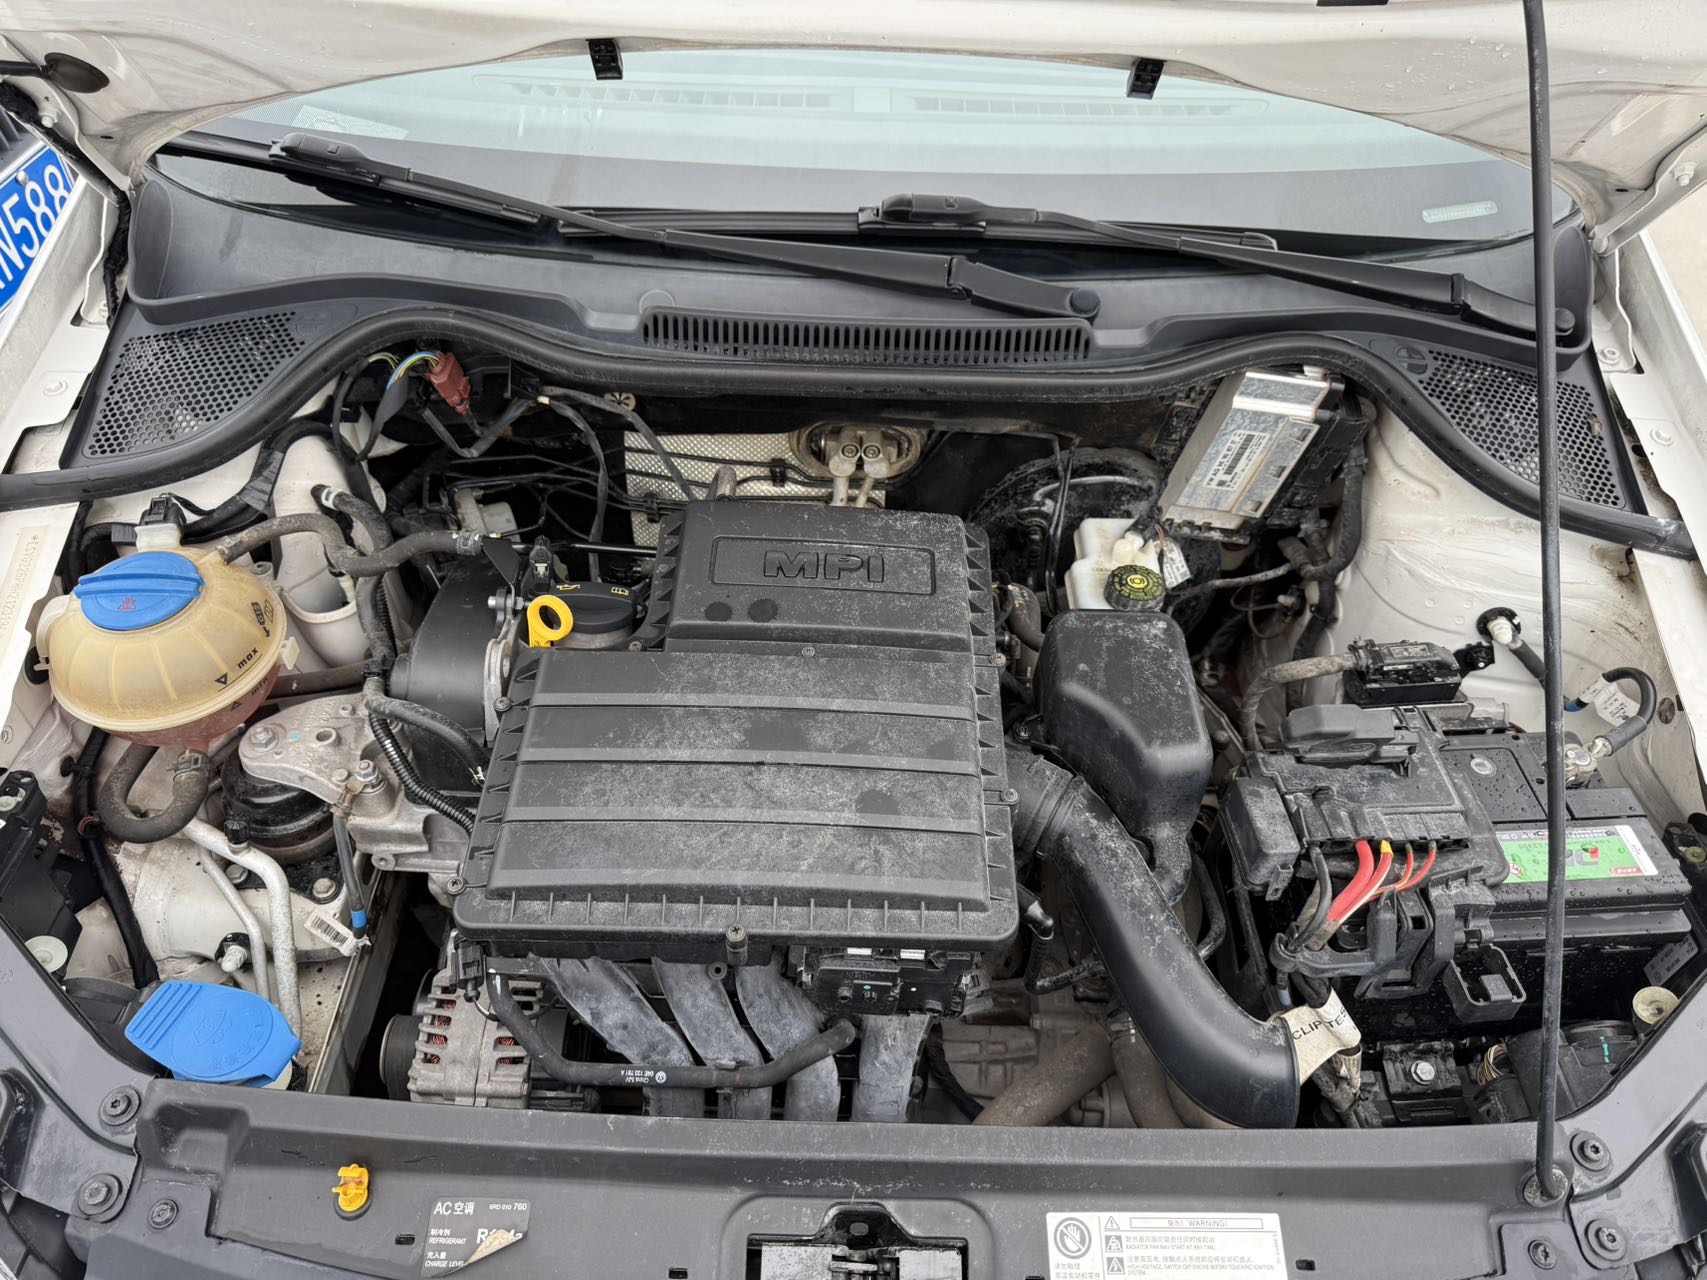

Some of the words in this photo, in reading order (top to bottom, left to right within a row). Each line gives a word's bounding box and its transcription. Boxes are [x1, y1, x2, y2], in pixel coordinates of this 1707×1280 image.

[0, 164, 70, 289] N588
[763, 550, 885, 582] MPI
[237, 647, 258, 669] max
[1292, 1020, 1322, 1040] CLIP
[433, 1201, 452, 1215] AC
[453, 1201, 475, 1216] 空调
[513, 1202, 528, 1211] 760
[1188, 1219, 1227, 1227] WARNING!
[448, 1260, 465, 1268] LEVEL
